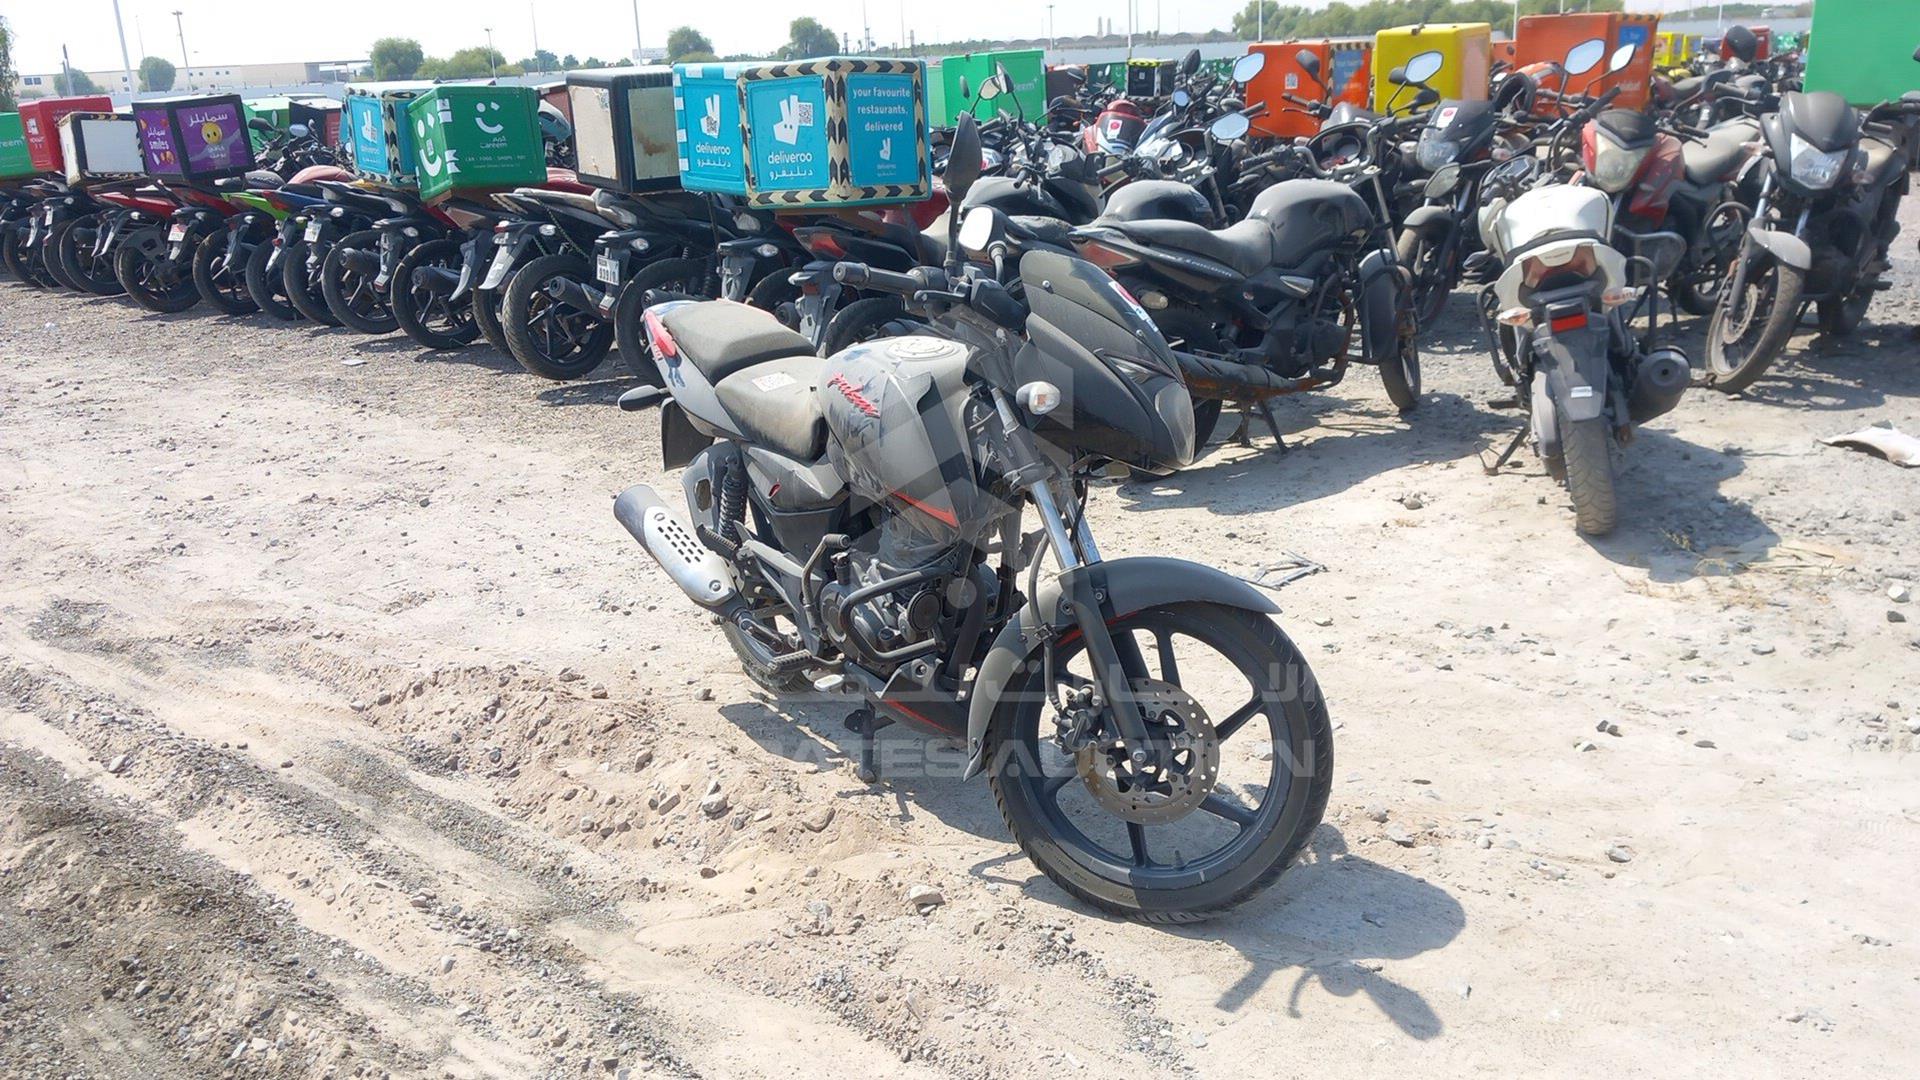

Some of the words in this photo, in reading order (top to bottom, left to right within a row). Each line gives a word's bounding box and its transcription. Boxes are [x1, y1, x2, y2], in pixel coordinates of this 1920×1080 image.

[853, 88, 871, 99] your
[873, 87, 911, 97] favourite
[189, 112, 228, 127] سمايلز
[864, 121, 904, 132] delivered
[0, 139, 22, 148] reem
[695, 142, 732, 156] deliveroo
[767, 150, 813, 165] deliveroo
